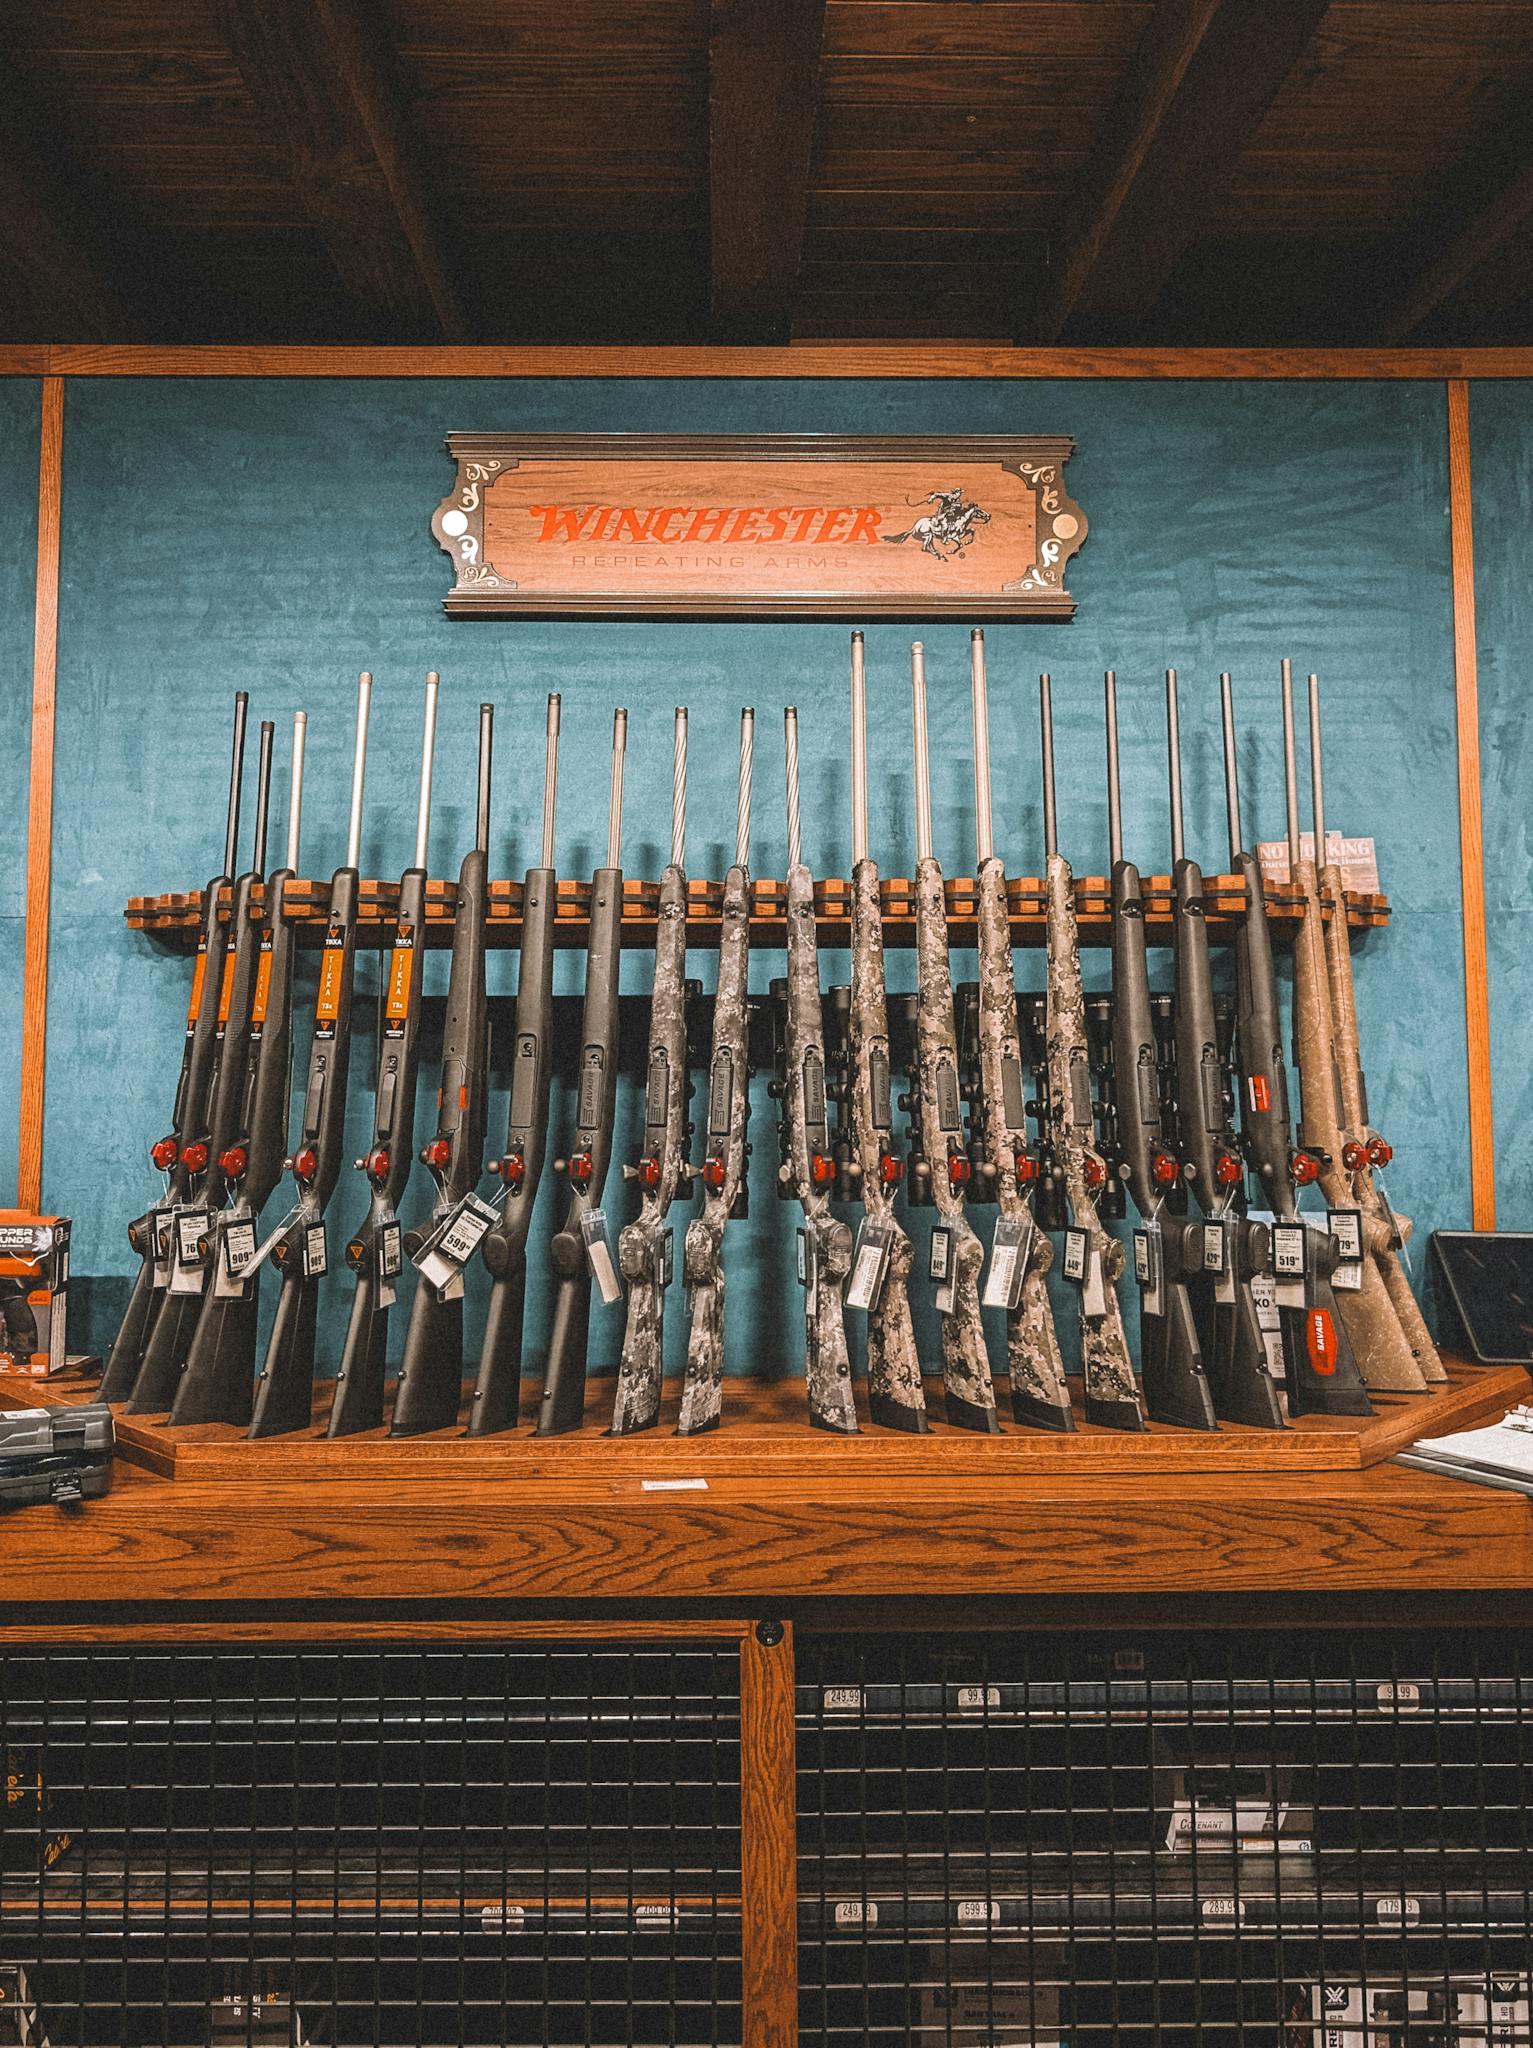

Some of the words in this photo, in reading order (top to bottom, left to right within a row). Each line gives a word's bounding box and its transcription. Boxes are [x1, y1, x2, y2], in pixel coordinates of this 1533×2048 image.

[530, 504, 882, 545] WINCHESTER
[572, 556, 745, 568] REPEATING
[764, 557, 849, 568] ARMS
[1260, 845, 1283, 859] NO
[325, 955, 334, 996] TIKKA
[395, 954, 405, 995] TIKKA
[717, 1073, 725, 1108] SAVAGE
[0, 1228, 33, 1236] PPER
[1, 1236, 33, 1244] UNDS
[1315, 1314, 1325, 1351] SAVAGE
[967, 1689, 991, 1702] 99.9
[1387, 1686, 1411, 1698] 9.99
[1180, 1818, 1223, 1830] COENANT
[842, 1903, 871, 1917] 249.9
[965, 1902, 992, 1916] 599.9
[1209, 1900, 1236, 1913] 289.9
